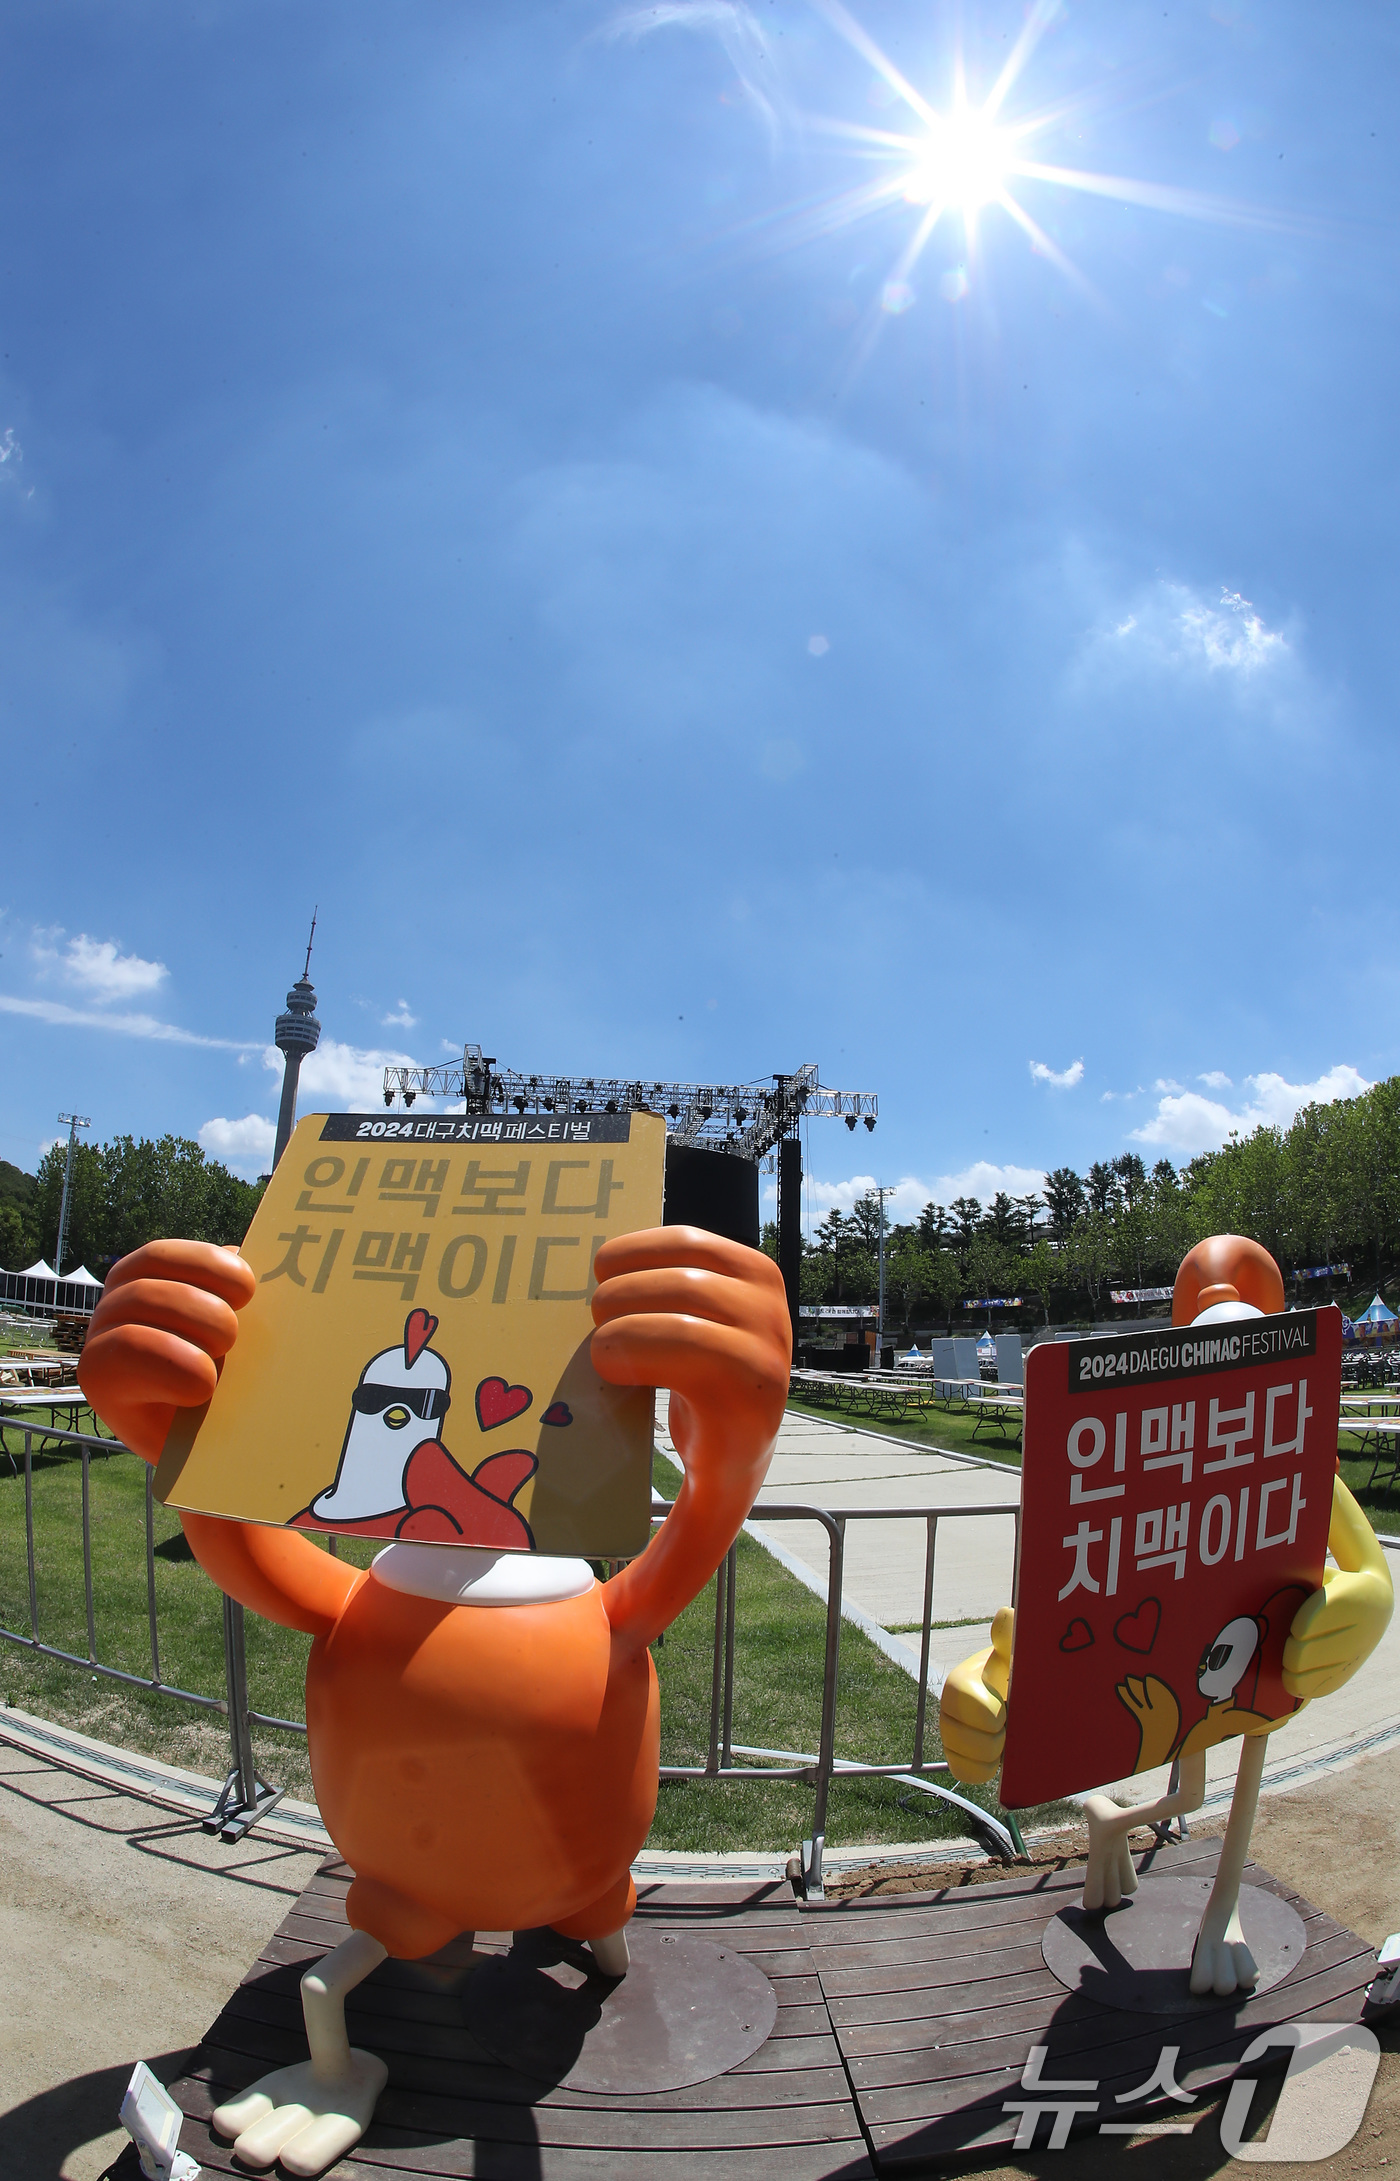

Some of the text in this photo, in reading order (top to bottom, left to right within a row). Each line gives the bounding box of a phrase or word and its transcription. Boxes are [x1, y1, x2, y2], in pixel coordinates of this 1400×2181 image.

[294, 1156, 624, 1219] 인맥보다
[1079, 1326, 1310, 1380] 2024 DAEGU CHIMAC FESTIVAL
[1066, 1379, 1313, 1505] 인맥보다
[1058, 1473, 1307, 1602] 치맥이다
